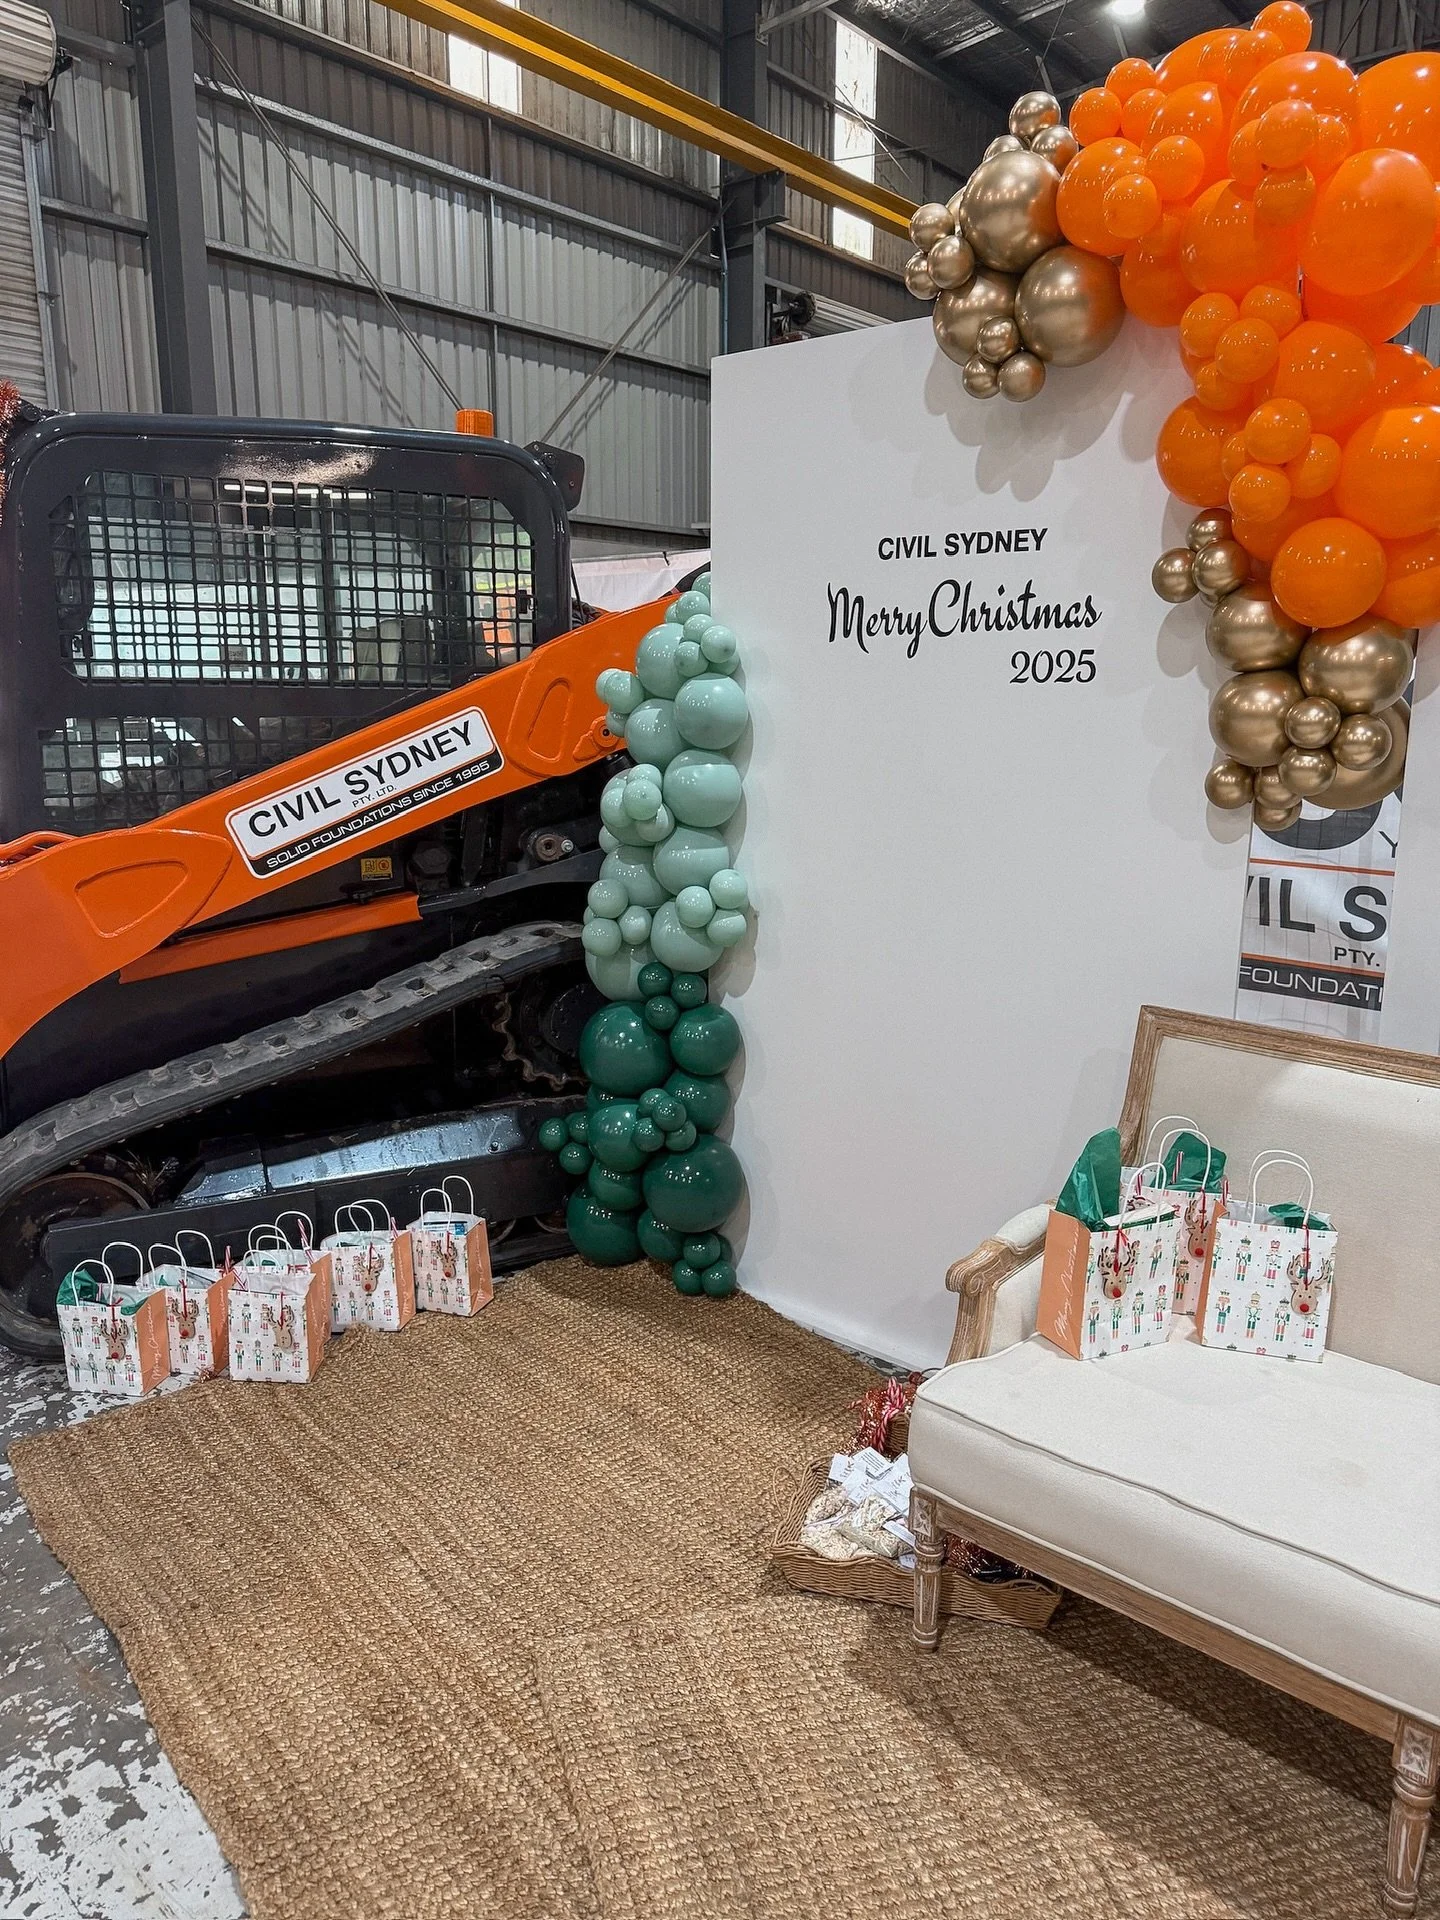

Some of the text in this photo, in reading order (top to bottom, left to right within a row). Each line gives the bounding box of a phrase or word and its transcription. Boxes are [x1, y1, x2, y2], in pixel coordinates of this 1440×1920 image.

[878, 528, 1048, 560] CIVIL SYDNEY
[827, 579, 1102, 659] Merry Christmas
[1009, 649, 1096, 684] 2025
[249, 720, 473, 837] CIVIL SYDNEY
[352, 784, 397, 808] PTY. LTD.
[266, 761, 490, 868] SOLID FOUNDATIONS SINCE 1995
[1246, 876, 1316, 933] IL
[1334, 946, 1380, 967] PTY.
